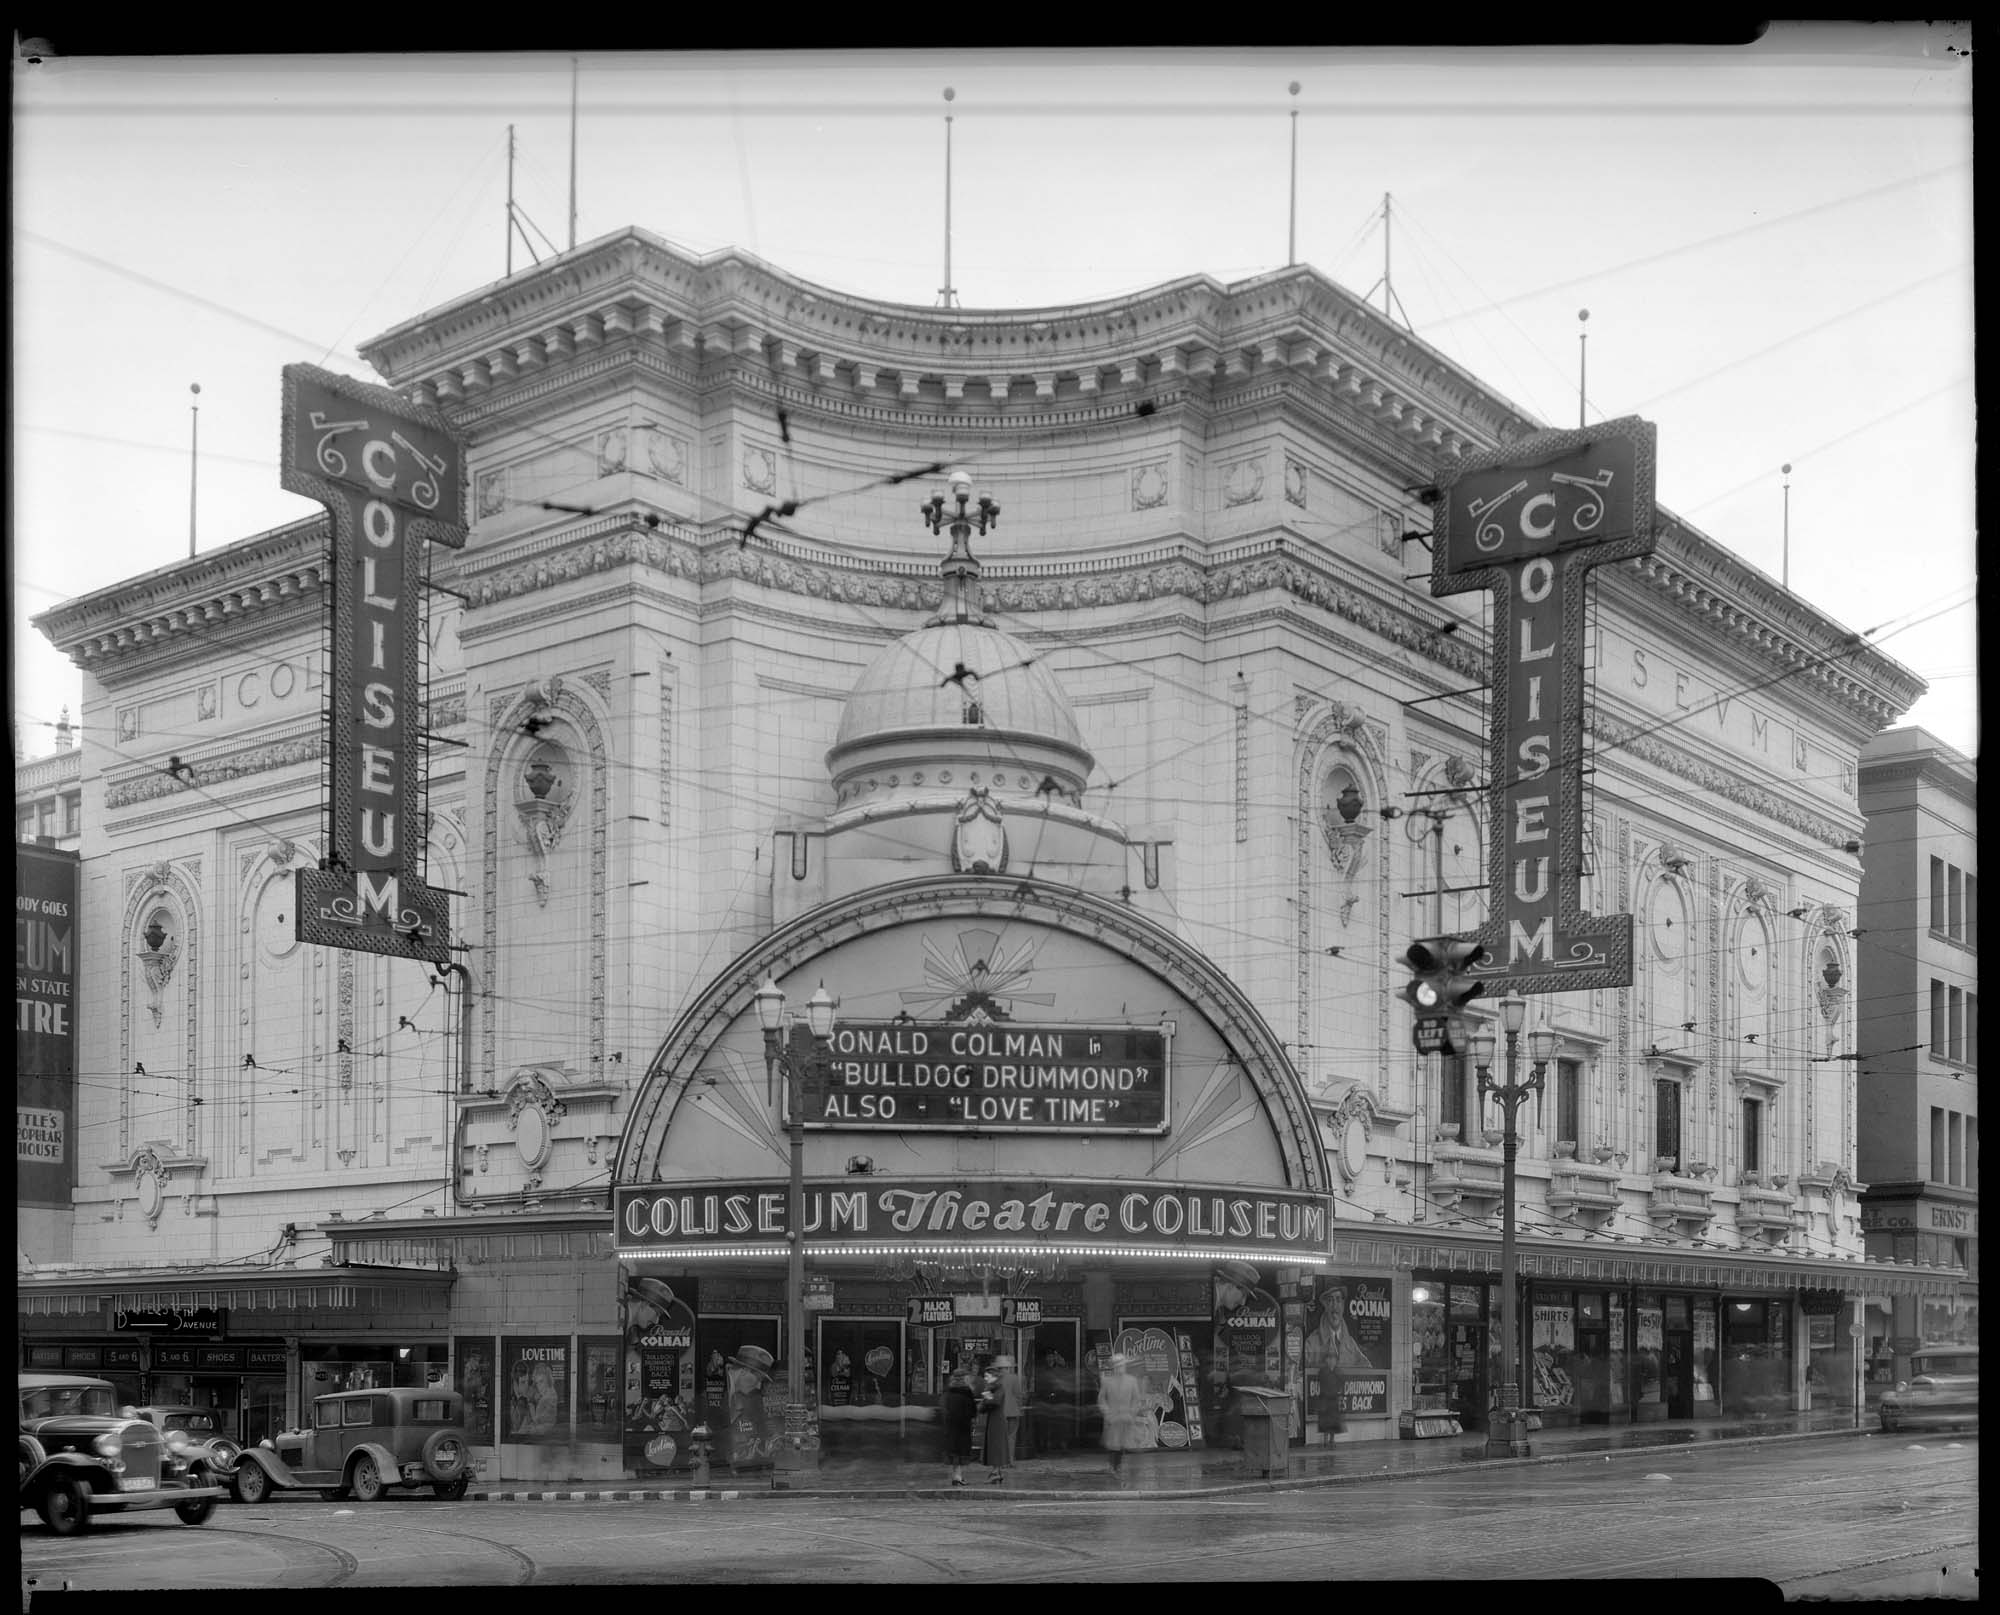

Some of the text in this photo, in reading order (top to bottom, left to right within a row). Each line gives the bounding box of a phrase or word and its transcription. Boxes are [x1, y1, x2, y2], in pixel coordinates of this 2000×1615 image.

[356, 440, 400, 919] COLISEUM
[1508, 493, 1558, 966] COLISEUM
[41, 900, 68, 917] GOES
[31, 978, 70, 997] STATE
[16, 998, 69, 1036] TRE
[950, 1033, 1064, 1057] COLMAN
[830, 1062, 1149, 1091] "BULLDOG DRUMMOND"
[824, 1094, 897, 1119] ALSO
[950, 1096, 1034, 1122] "LOVE
[1045, 1097, 1121, 1123] TIME"
[18, 1142, 60, 1158] HOUSE
[625, 1189, 1326, 1242] COLISEUM Theatre COLISEUM
[1932, 1207, 1970, 1231] ERNST
[908, 1299, 951, 1323] 2 MAJOR
[923, 1311, 953, 1322] FEATURES
[1003, 1299, 1039, 1324] 2 MAJOR
[1016, 1311, 1041, 1322] FEATURES
[1349, 1299, 1391, 1318] COLMAN
[1535, 1310, 1569, 1322] SHIRTS
[183, 1321, 218, 1329] AVENUE
[1227, 1317, 1276, 1328] COLMAN
[640, 1336, 691, 1347] COLMAN
[207, 1353, 235, 1362] SHOES
[1344, 1380, 1386, 1395] DRUMMOND
[1352, 1395, 1373, 1411] BACK
